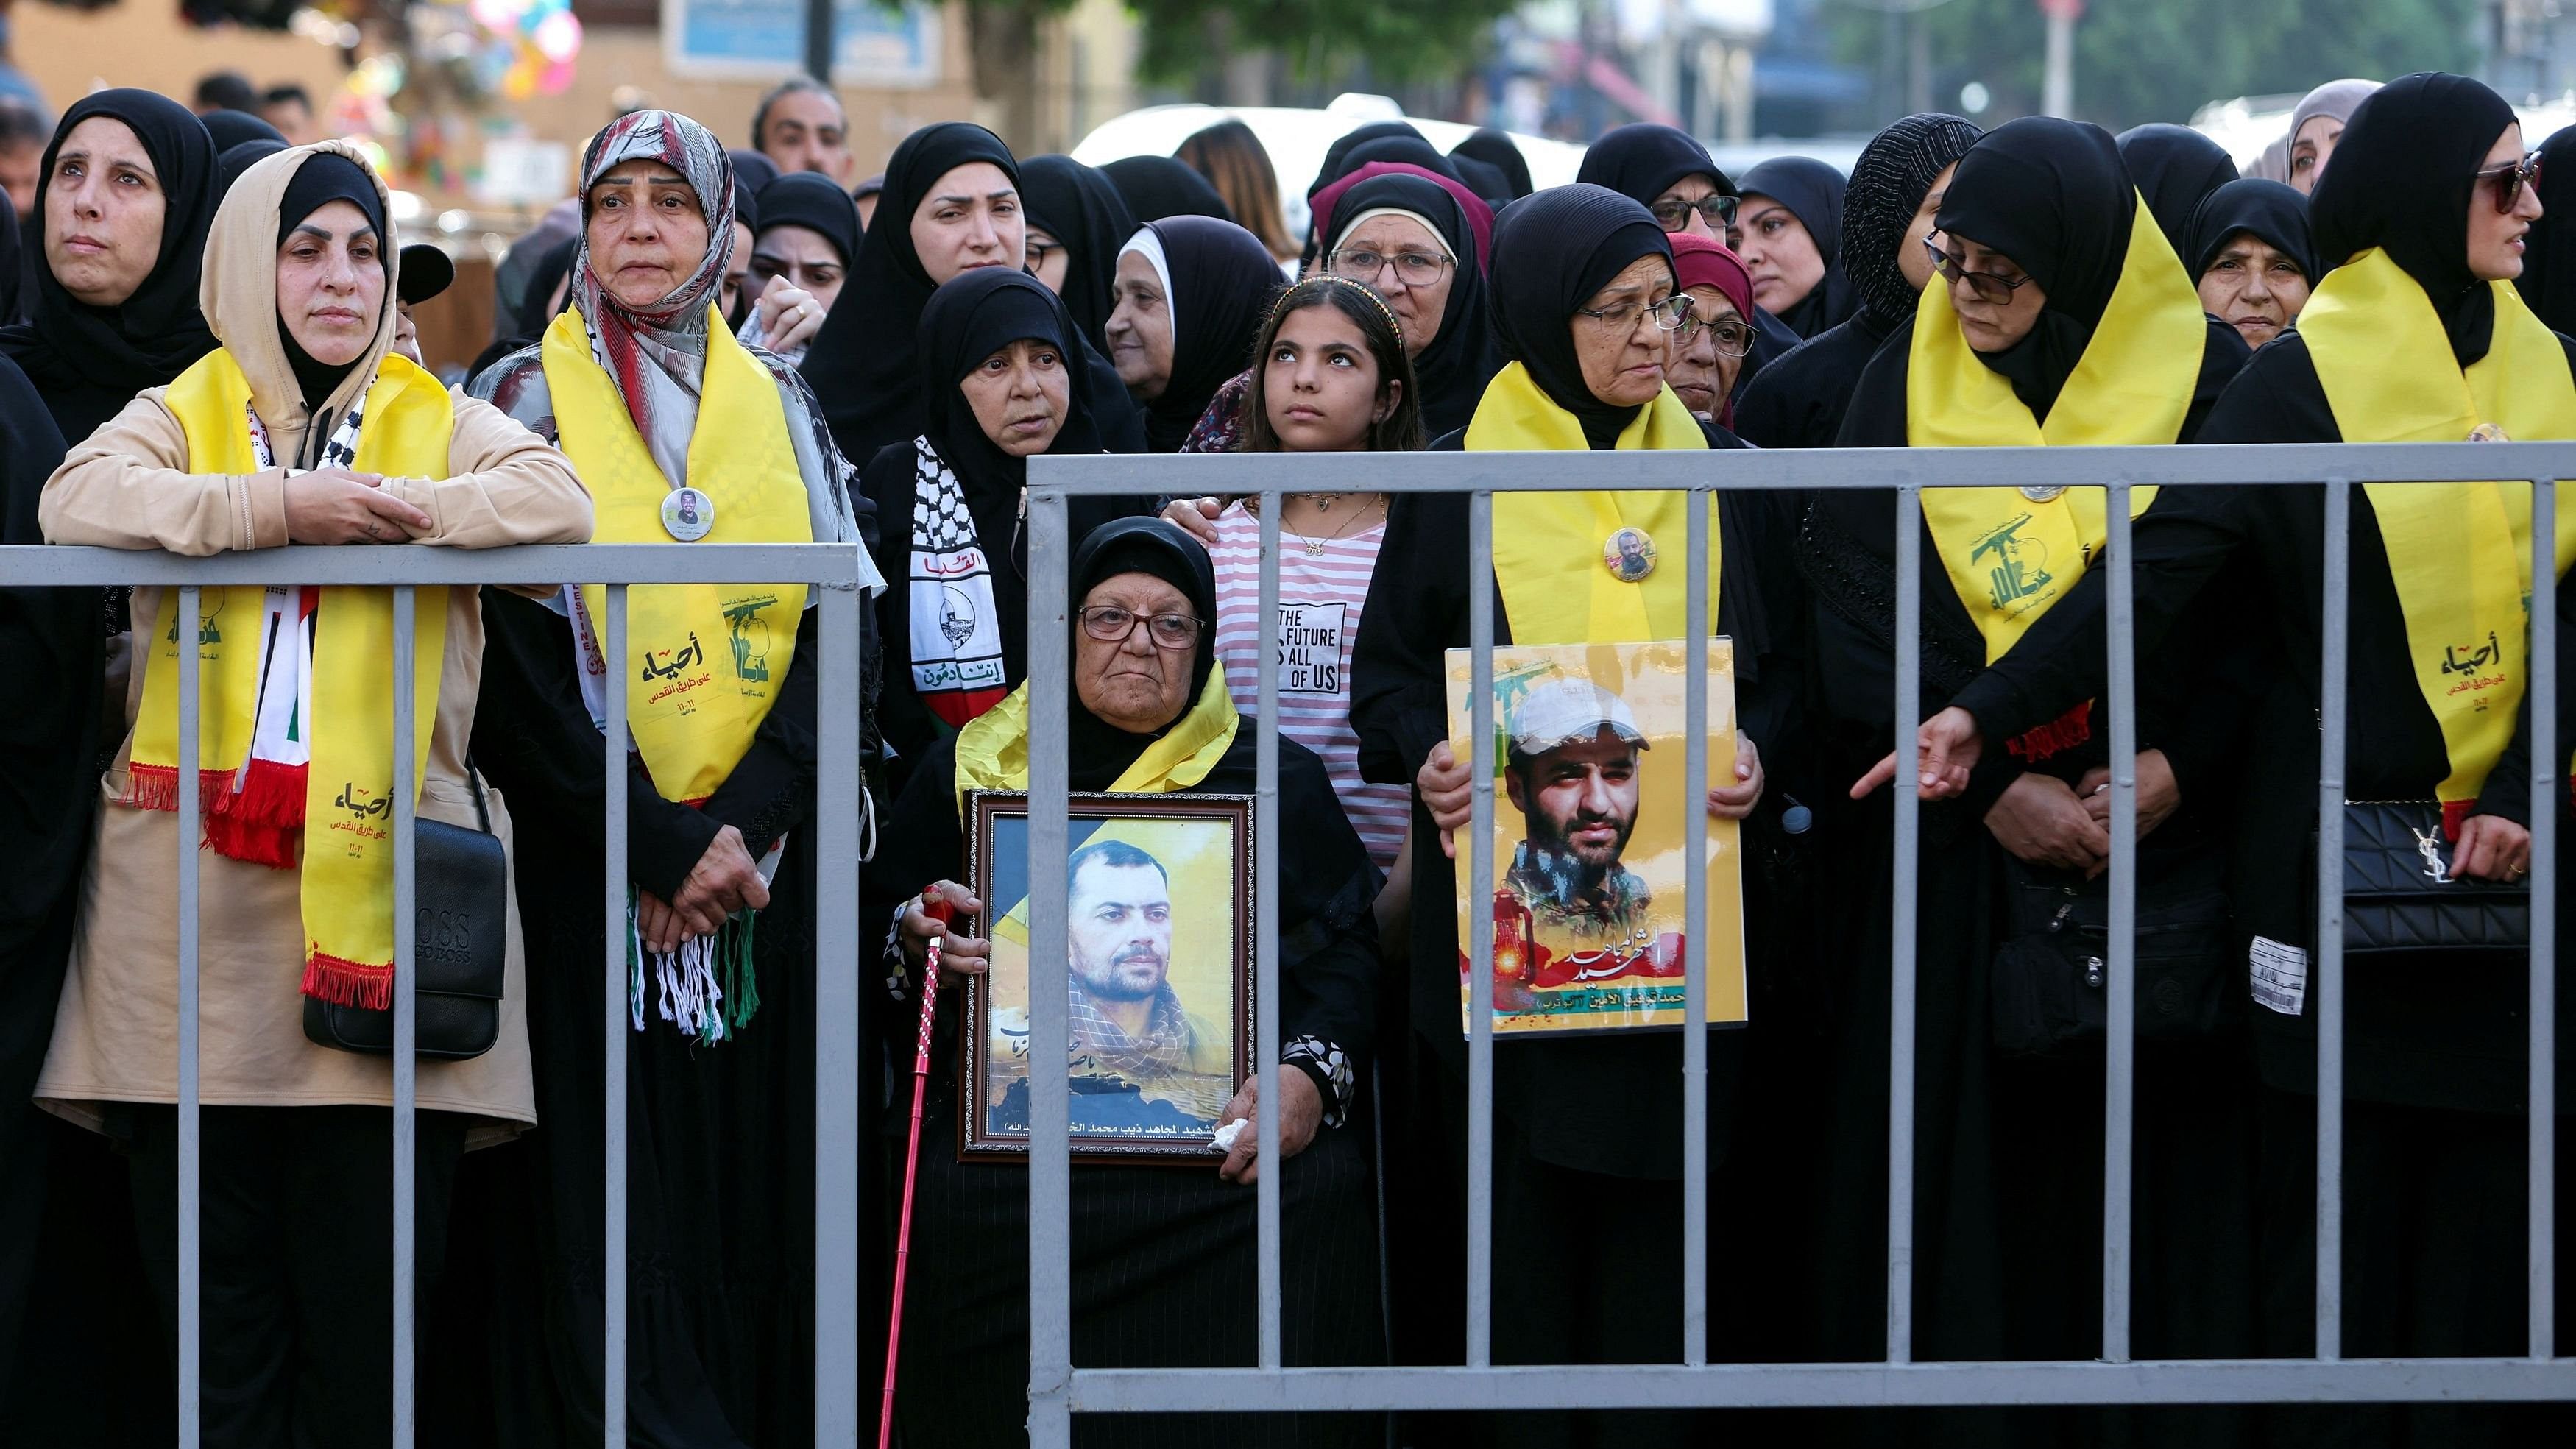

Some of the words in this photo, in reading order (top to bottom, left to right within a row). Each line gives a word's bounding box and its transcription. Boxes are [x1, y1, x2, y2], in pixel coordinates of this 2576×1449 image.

[572, 584, 590, 651] LESTINE
[1279, 610, 1302, 626] THE
[1287, 628, 1335, 646] FUTURE
[642, 631, 704, 682] أحياء
[1288, 648, 1312, 666] ALL
[2441, 630, 2500, 676] أحياء
[676, 677, 697, 693] طريق
[696, 673, 711, 687] على
[1291, 670, 1307, 687] OF
[1313, 665, 1336, 690] US
[648, 684, 676, 705] القدس
[330, 821, 357, 832] القدس
[356, 823, 374, 837] طريق
[373, 829, 387, 840] على
[415, 907, 471, 949] OSS
[1659, 990, 1685, 1005] حمد
[1088, 1122, 1119, 1133] محمد
[1120, 1123, 1142, 1136] ذيب
[1145, 1124, 1181, 1137] المجاهد
[1182, 1125, 1215, 1137] لشهيد
